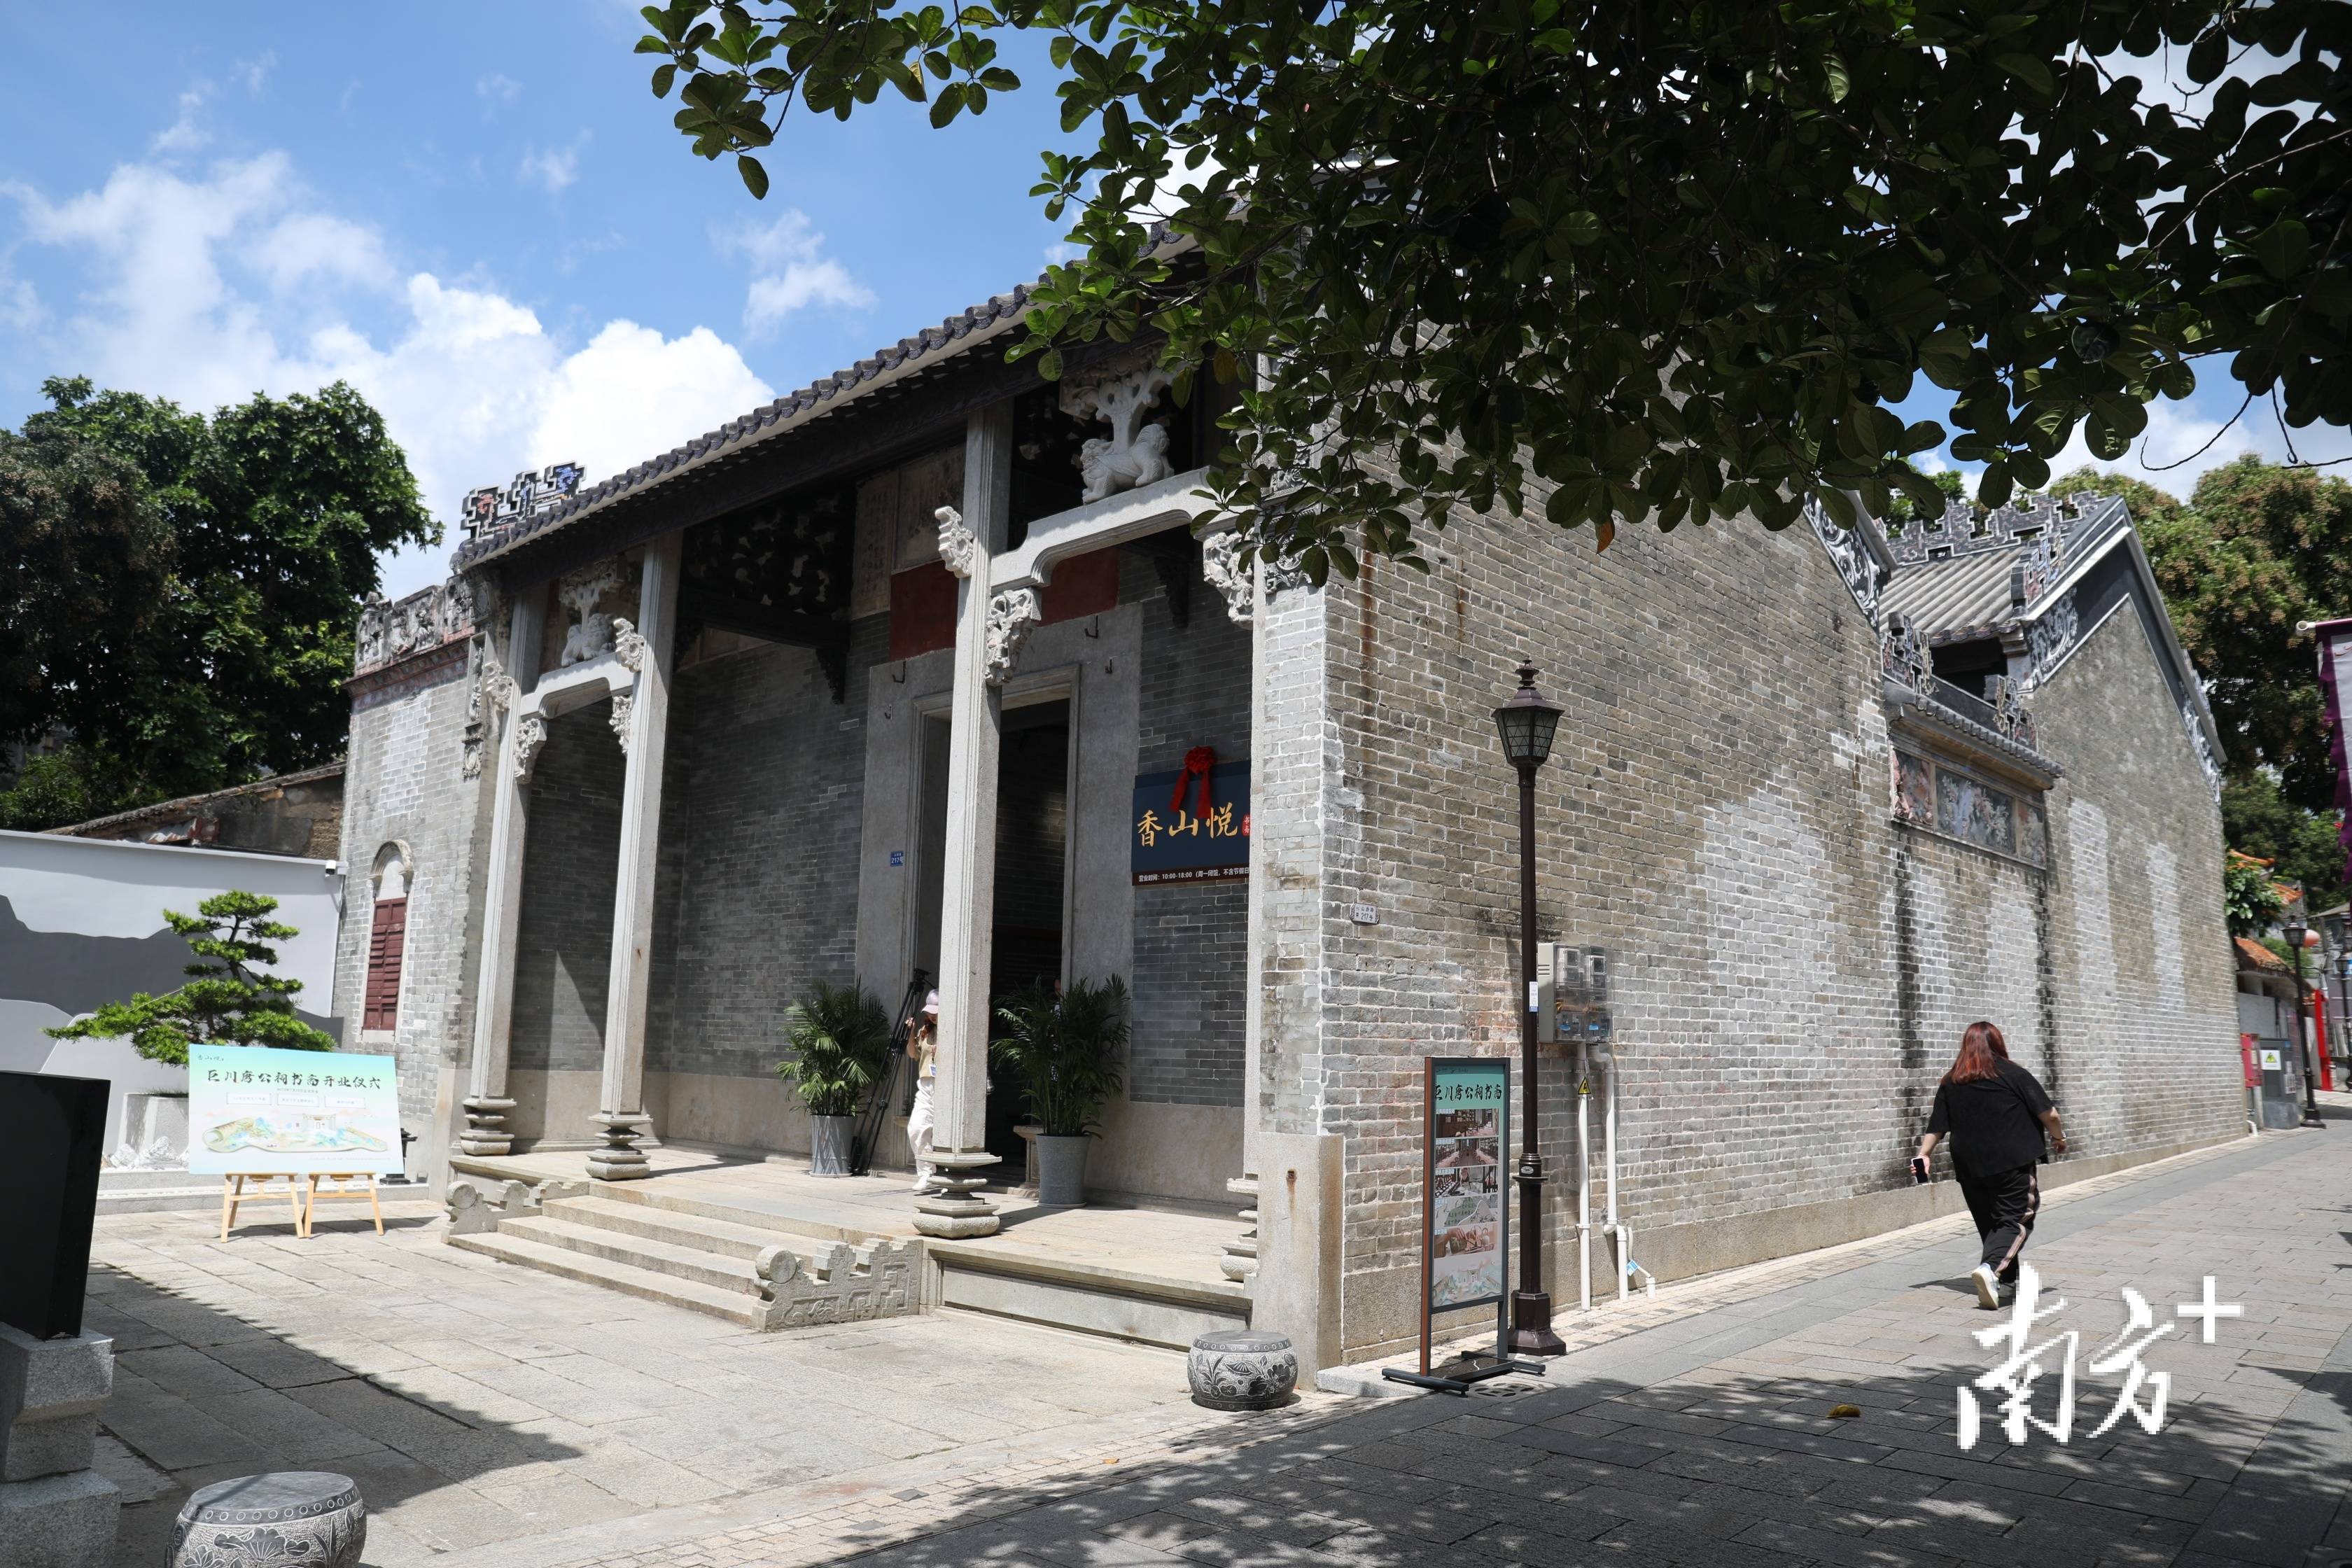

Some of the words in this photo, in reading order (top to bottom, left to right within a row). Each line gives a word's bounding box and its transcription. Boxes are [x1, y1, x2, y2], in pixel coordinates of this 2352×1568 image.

[1137, 802, 1238, 847] 香山悦
[1361, 912, 1373, 921] 217号
[208, 1069, 381, 1090] 巨川唐公祠书斋开业仪式
